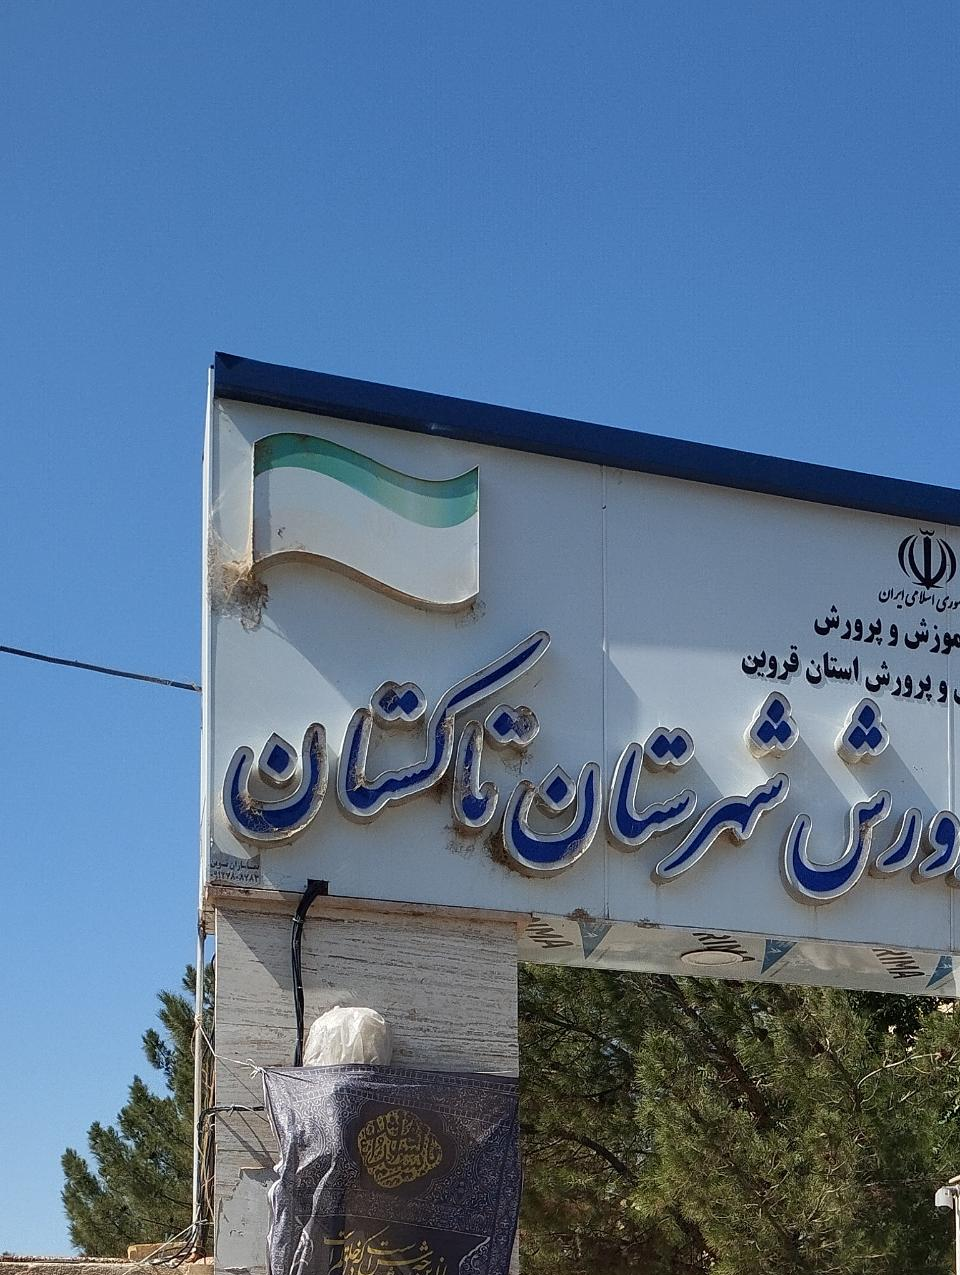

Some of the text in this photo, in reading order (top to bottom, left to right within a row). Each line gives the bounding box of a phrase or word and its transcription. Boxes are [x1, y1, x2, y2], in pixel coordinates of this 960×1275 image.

[878, 588, 905, 610] ایران
[813, 605, 883, 645] پرورش
[888, 626, 899, 647] و
[805, 652, 860, 685] استان
[865, 661, 932, 701] پرورش
[937, 683, 948, 701] و
[222, 630, 552, 843] تاکستان
[503, 691, 800, 883] شهرستان
